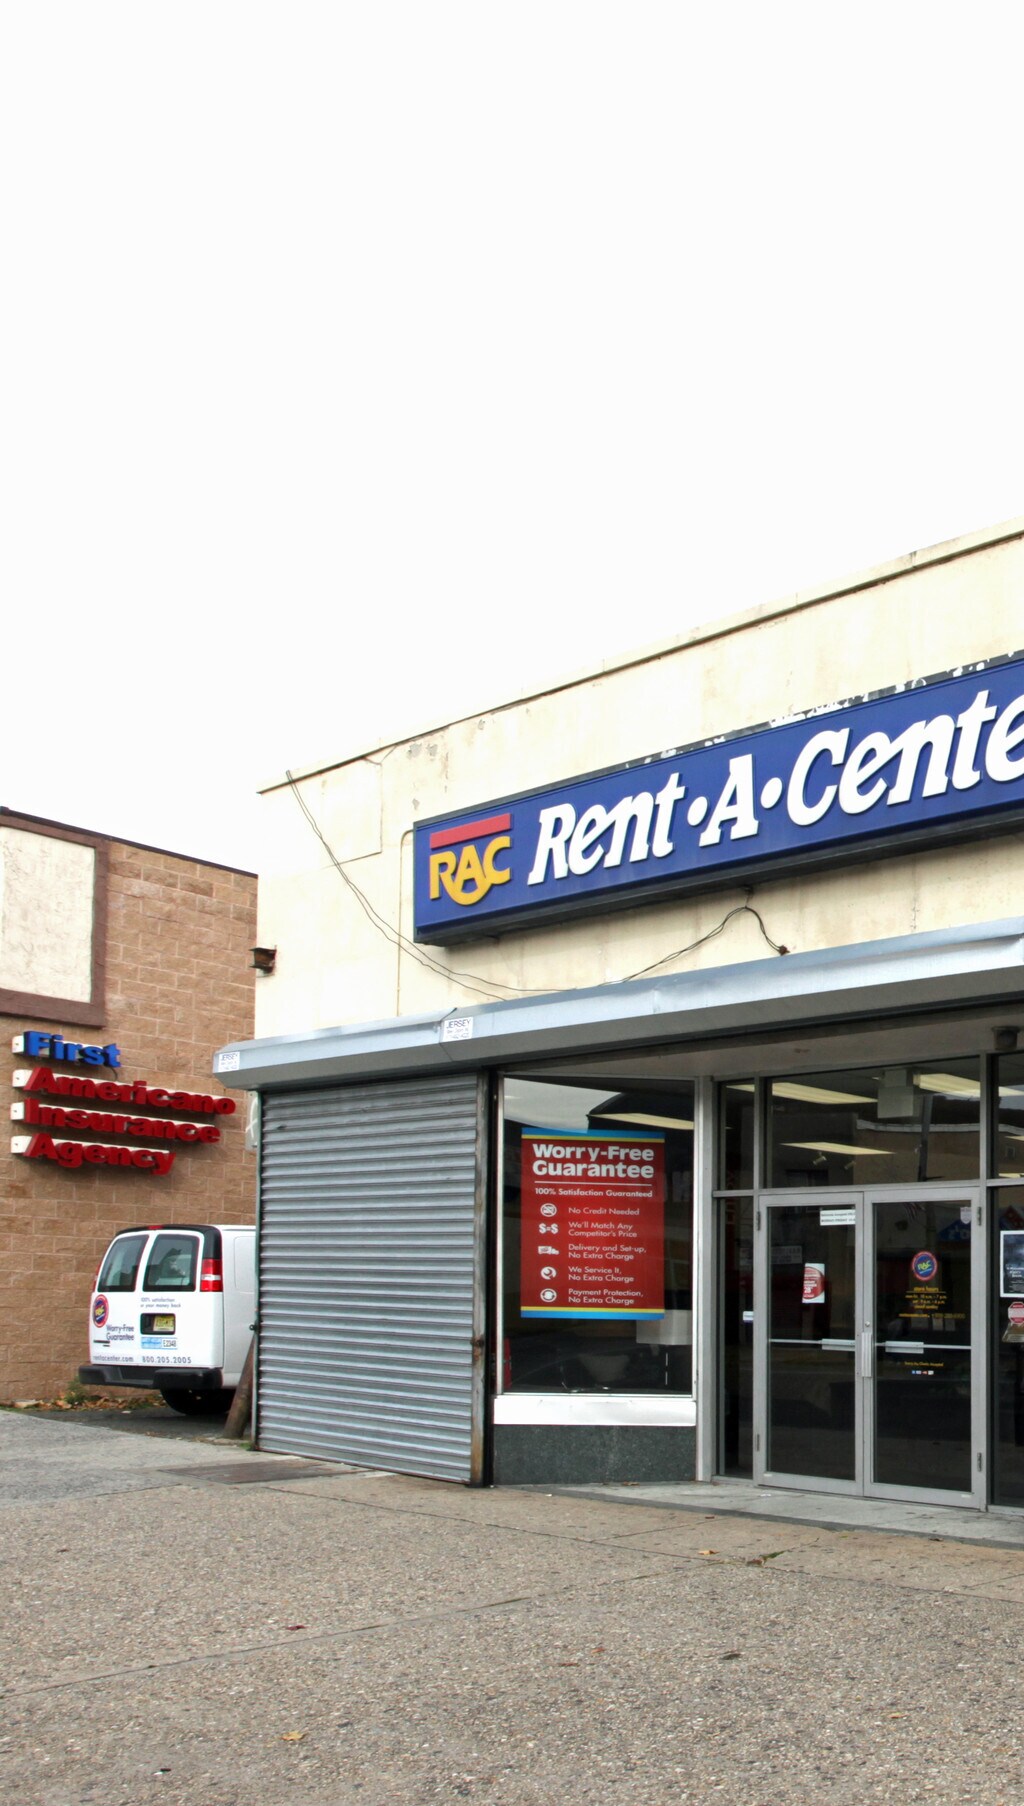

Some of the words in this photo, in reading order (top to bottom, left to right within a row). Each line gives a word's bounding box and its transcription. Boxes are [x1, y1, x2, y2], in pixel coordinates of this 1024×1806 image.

[429, 835, 512, 906] RAC
[23, 1031, 122, 1068] First
[24, 1067, 237, 1115] Americano
[24, 1097, 221, 1144] Insurance
[23, 1133, 177, 1177] Agency
[532, 1143, 655, 1161] Worry-Free
[532, 1160, 655, 1179] Guarantee
[535, 1187, 556, 1195] 100%
[558, 1188, 603, 1196] Satisfaction
[605, 1189, 653, 1198] Guaranteed
[583, 1207, 607, 1215] Credit
[609, 1208, 640, 1216] Needed
[568, 1221, 588, 1229] We'll
[617, 1223, 633, 1231] Any
[568, 1229, 616, 1238] Competitor's
[568, 1244, 600, 1252] Delivery
[602, 1244, 618, 1252] and
[605, 1253, 634, 1261] Charge
[584, 1266, 613, 1274] Service
[605, 1274, 634, 1283] Charge
[568, 1288, 601, 1297] Payment
[605, 1297, 635, 1306] Charge
